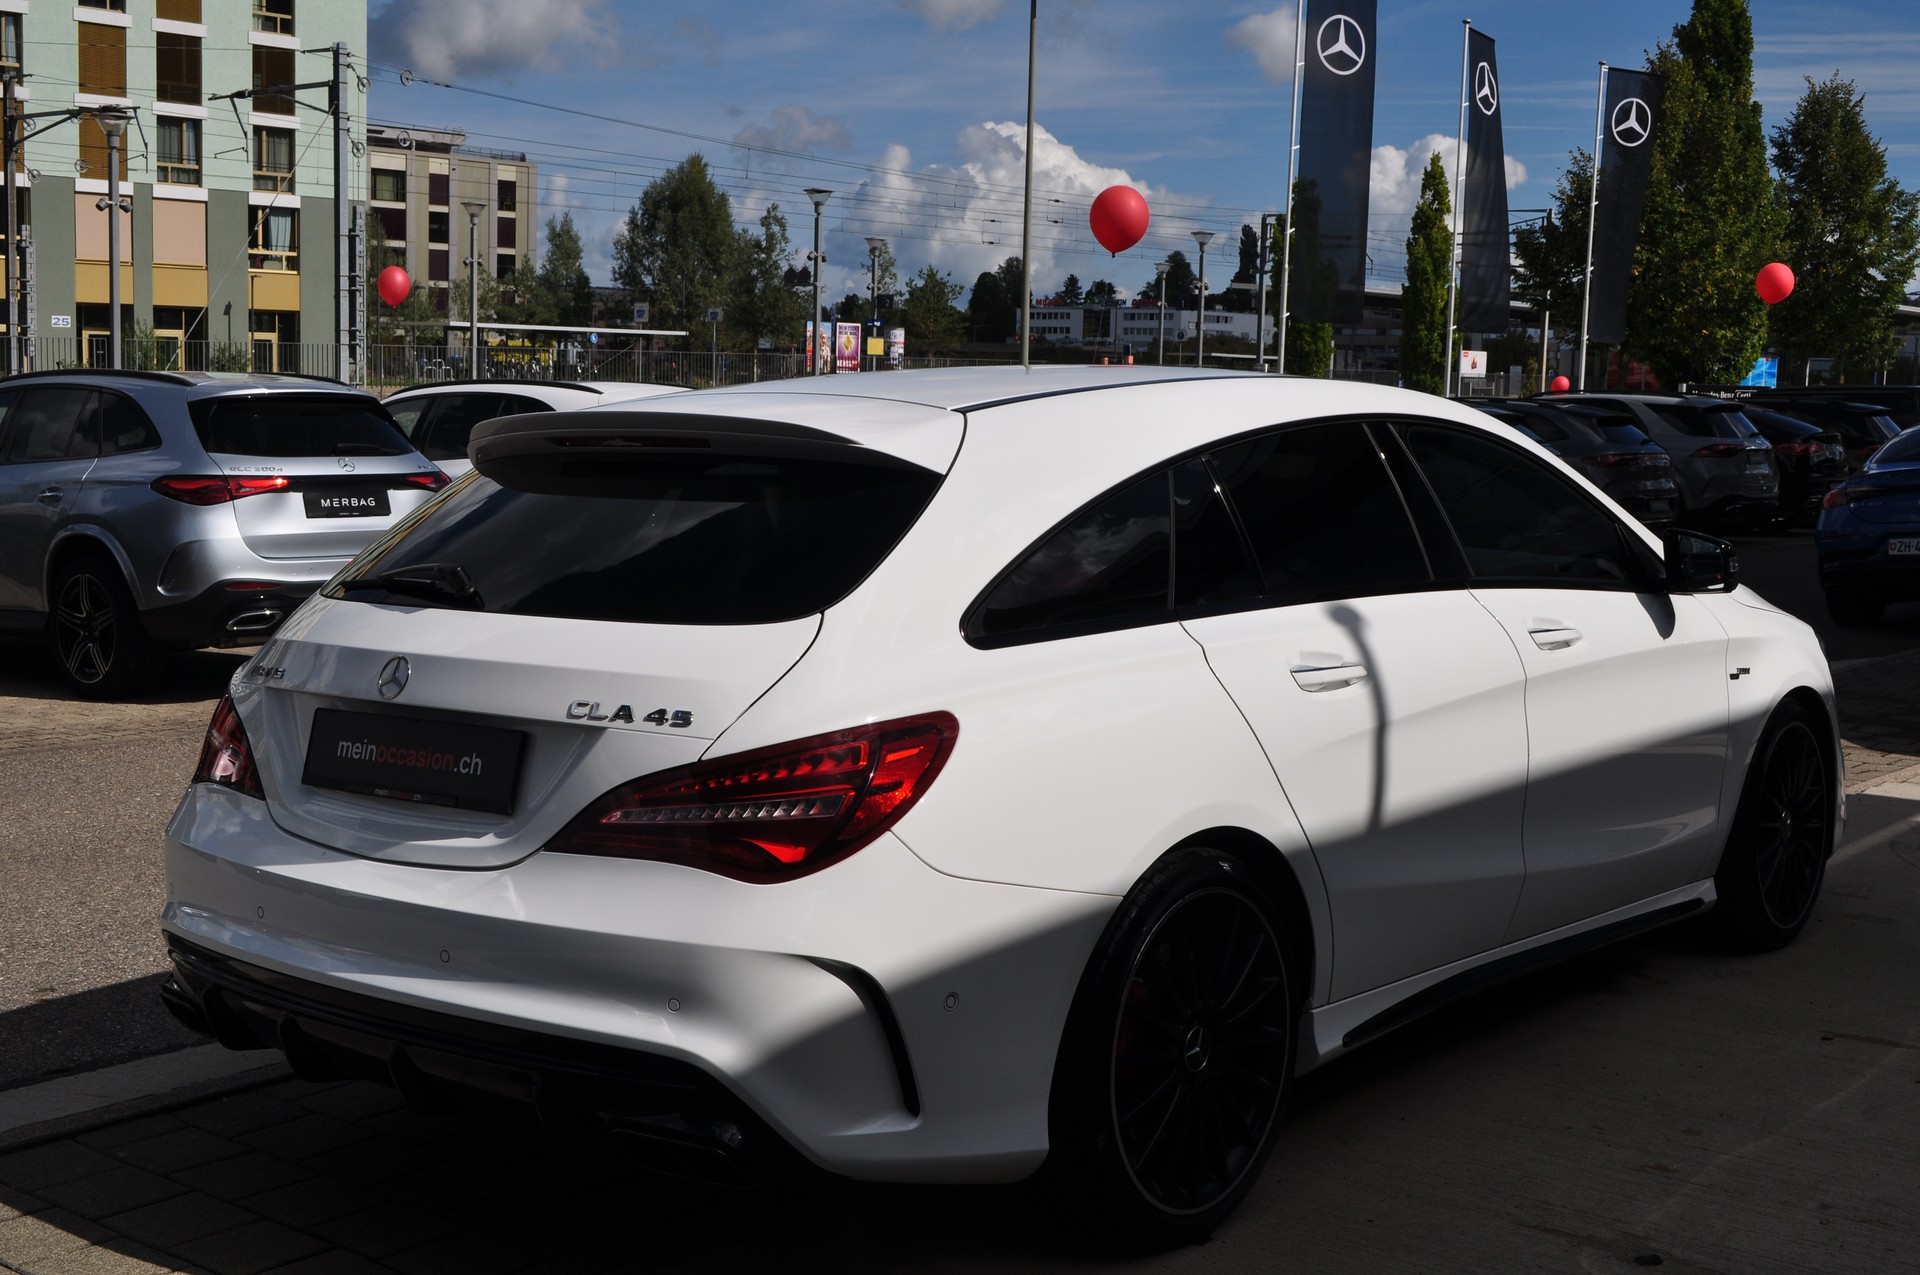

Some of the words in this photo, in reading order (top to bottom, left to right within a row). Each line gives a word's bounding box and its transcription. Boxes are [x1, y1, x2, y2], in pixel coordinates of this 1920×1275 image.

[53, 317, 69, 326] 25
[321, 497, 376, 507] MERBAG
[566, 700, 635, 723] CLA
[643, 708, 694, 728] 45
[337, 739, 482, 775] meinoccasion.ch
